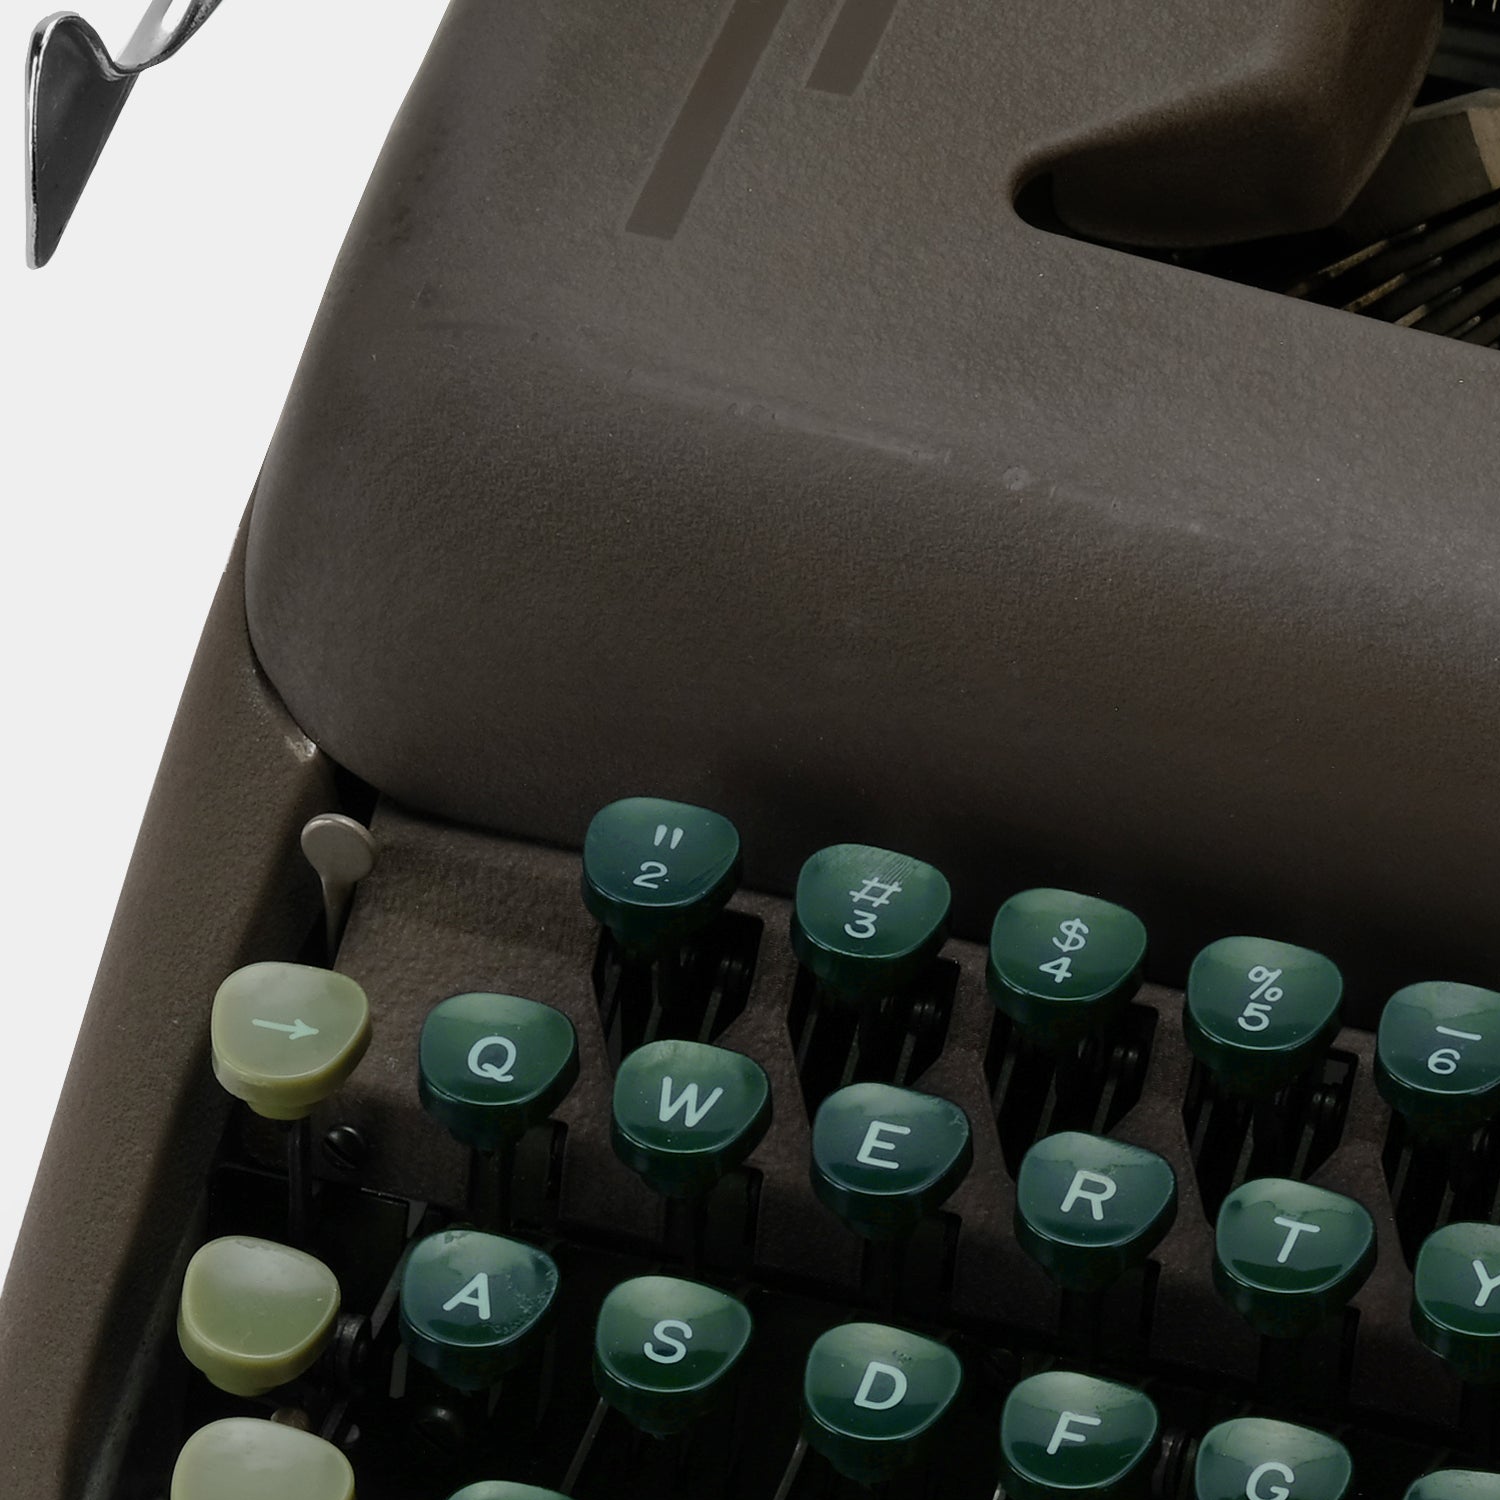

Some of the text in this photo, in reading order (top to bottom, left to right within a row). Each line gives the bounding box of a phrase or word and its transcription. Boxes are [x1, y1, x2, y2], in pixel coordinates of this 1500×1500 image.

[632, 861, 668, 889] 2
[849, 876, 903, 908] #
[844, 909, 878, 939] 3
[1052, 918, 1089, 953] $
[1038, 956, 1072, 983] 4
[1247, 965, 1283, 1002] %
[1237, 1002, 1273, 1032] 5
[467, 1035, 517, 1082] Q
[1427, 1048, 1461, 1075] 6
[658, 1075, 724, 1128] W
[856, 1120, 911, 1170] E
[1060, 1167, 1117, 1221] R
[1273, 1216, 1321, 1263] T
[442, 1271, 491, 1320] A
[643, 1315, 693, 1364] S
[853, 1357, 908, 1410] D
[1046, 1407, 1102, 1455] F
